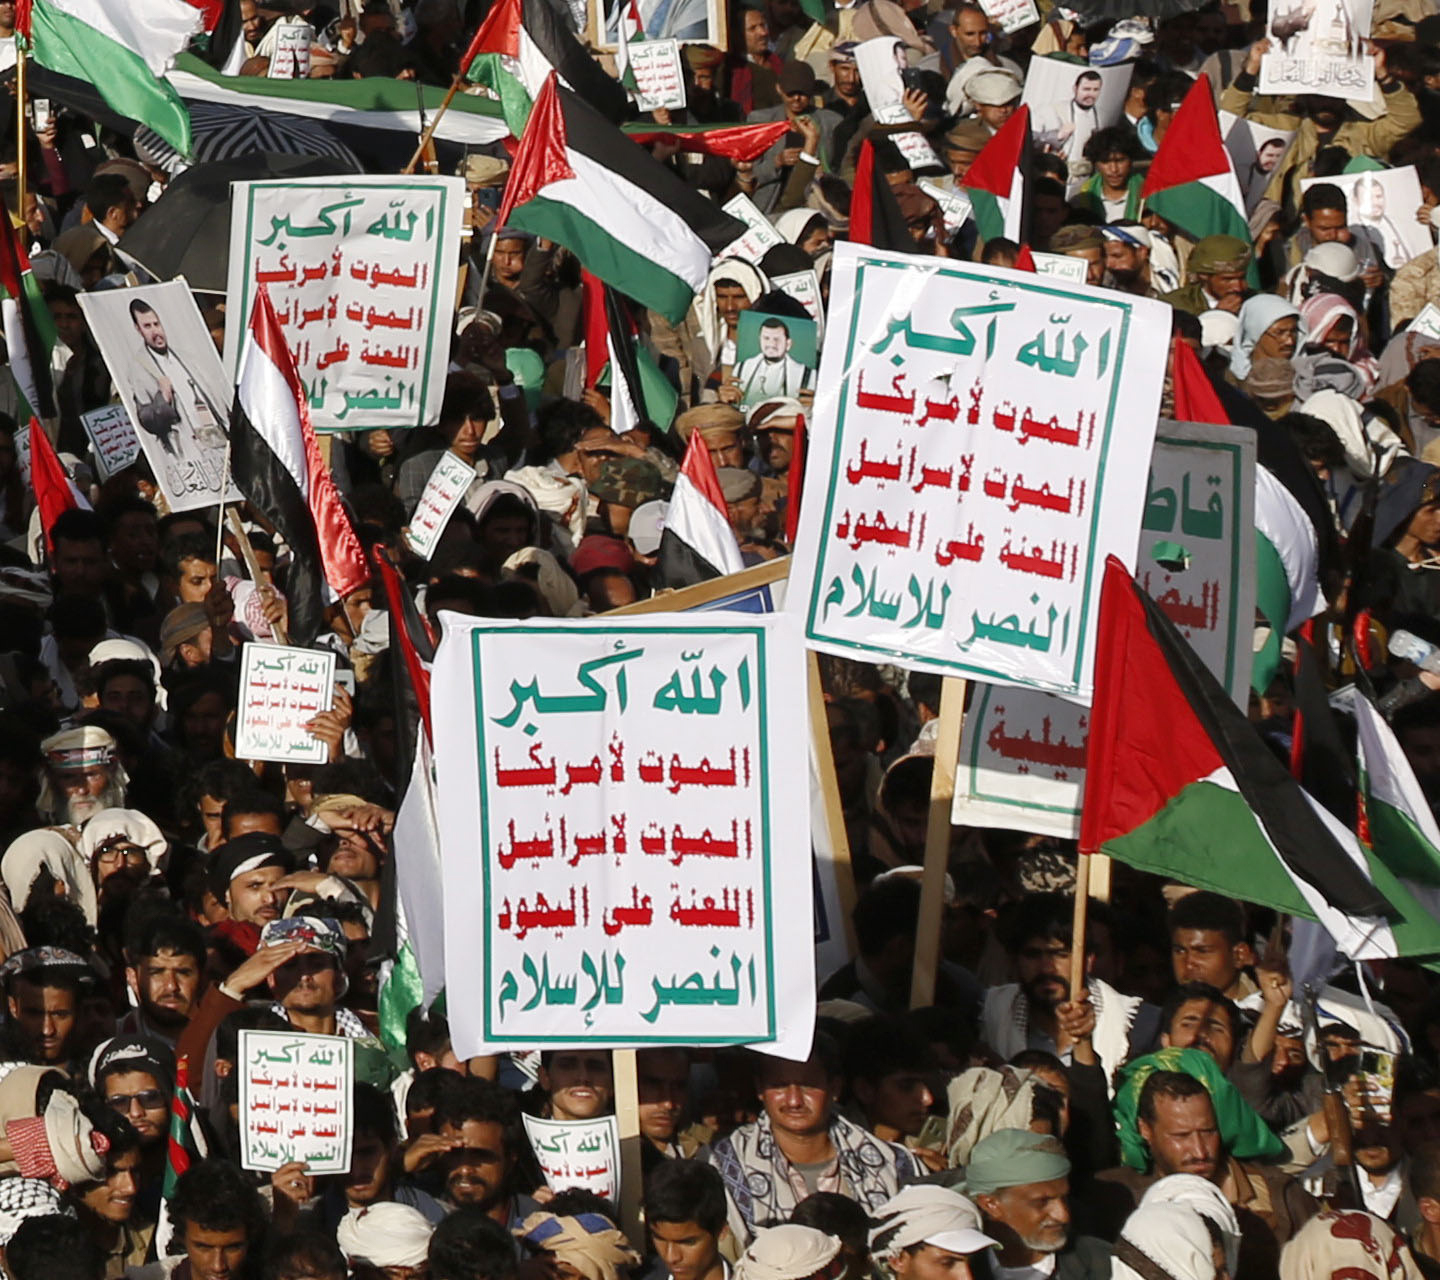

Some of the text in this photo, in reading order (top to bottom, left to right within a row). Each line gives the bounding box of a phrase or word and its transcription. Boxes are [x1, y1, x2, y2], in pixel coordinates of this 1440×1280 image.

[1015, 316, 1113, 379] الله
[853, 371, 1099, 451] الموت لأمريكا
[981, 467, 1088, 516] الموت
[834, 509, 1081, 582] اللعنة على اليهود
[959, 592, 1073, 655] النصر
[491, 642, 754, 739] الله أكبر
[493, 733, 753, 798] الموت لأمريكا
[637, 817, 755, 869] الموت
[496, 881, 757, 943] اللعنة على اليهود
[640, 944, 760, 1026] النصر
